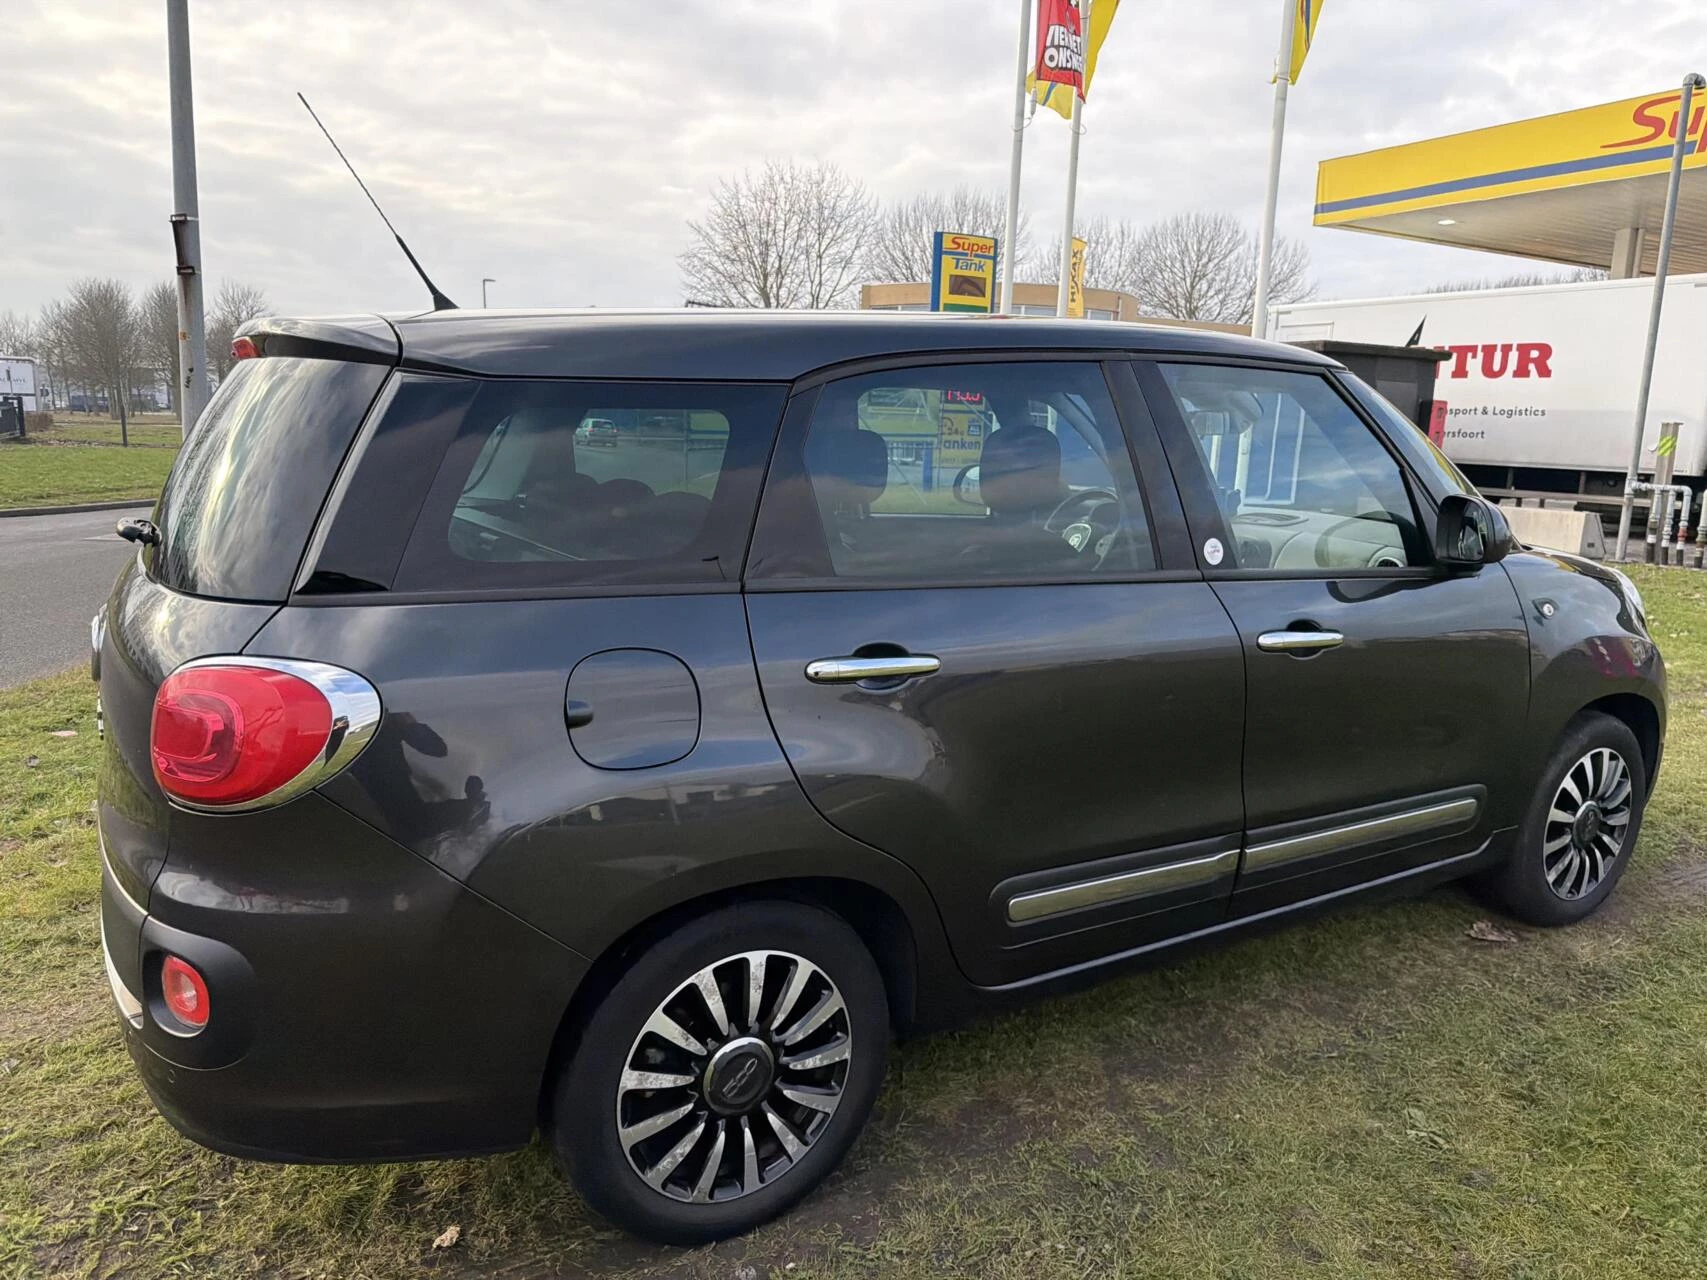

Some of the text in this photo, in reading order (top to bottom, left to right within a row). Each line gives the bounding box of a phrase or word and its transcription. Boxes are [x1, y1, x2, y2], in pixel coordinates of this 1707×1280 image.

[1600, 92, 1707, 153] Su
[943, 236, 993, 257] Super
[952, 257, 986, 272] Tank
[1433, 343, 1553, 379] TUR
[1445, 406, 1478, 418] sport
[1481, 406, 1489, 416] &
[1492, 406, 1546, 419] Logistics
[1443, 429, 1485, 440] rsfoort
[943, 437, 981, 450] anken
